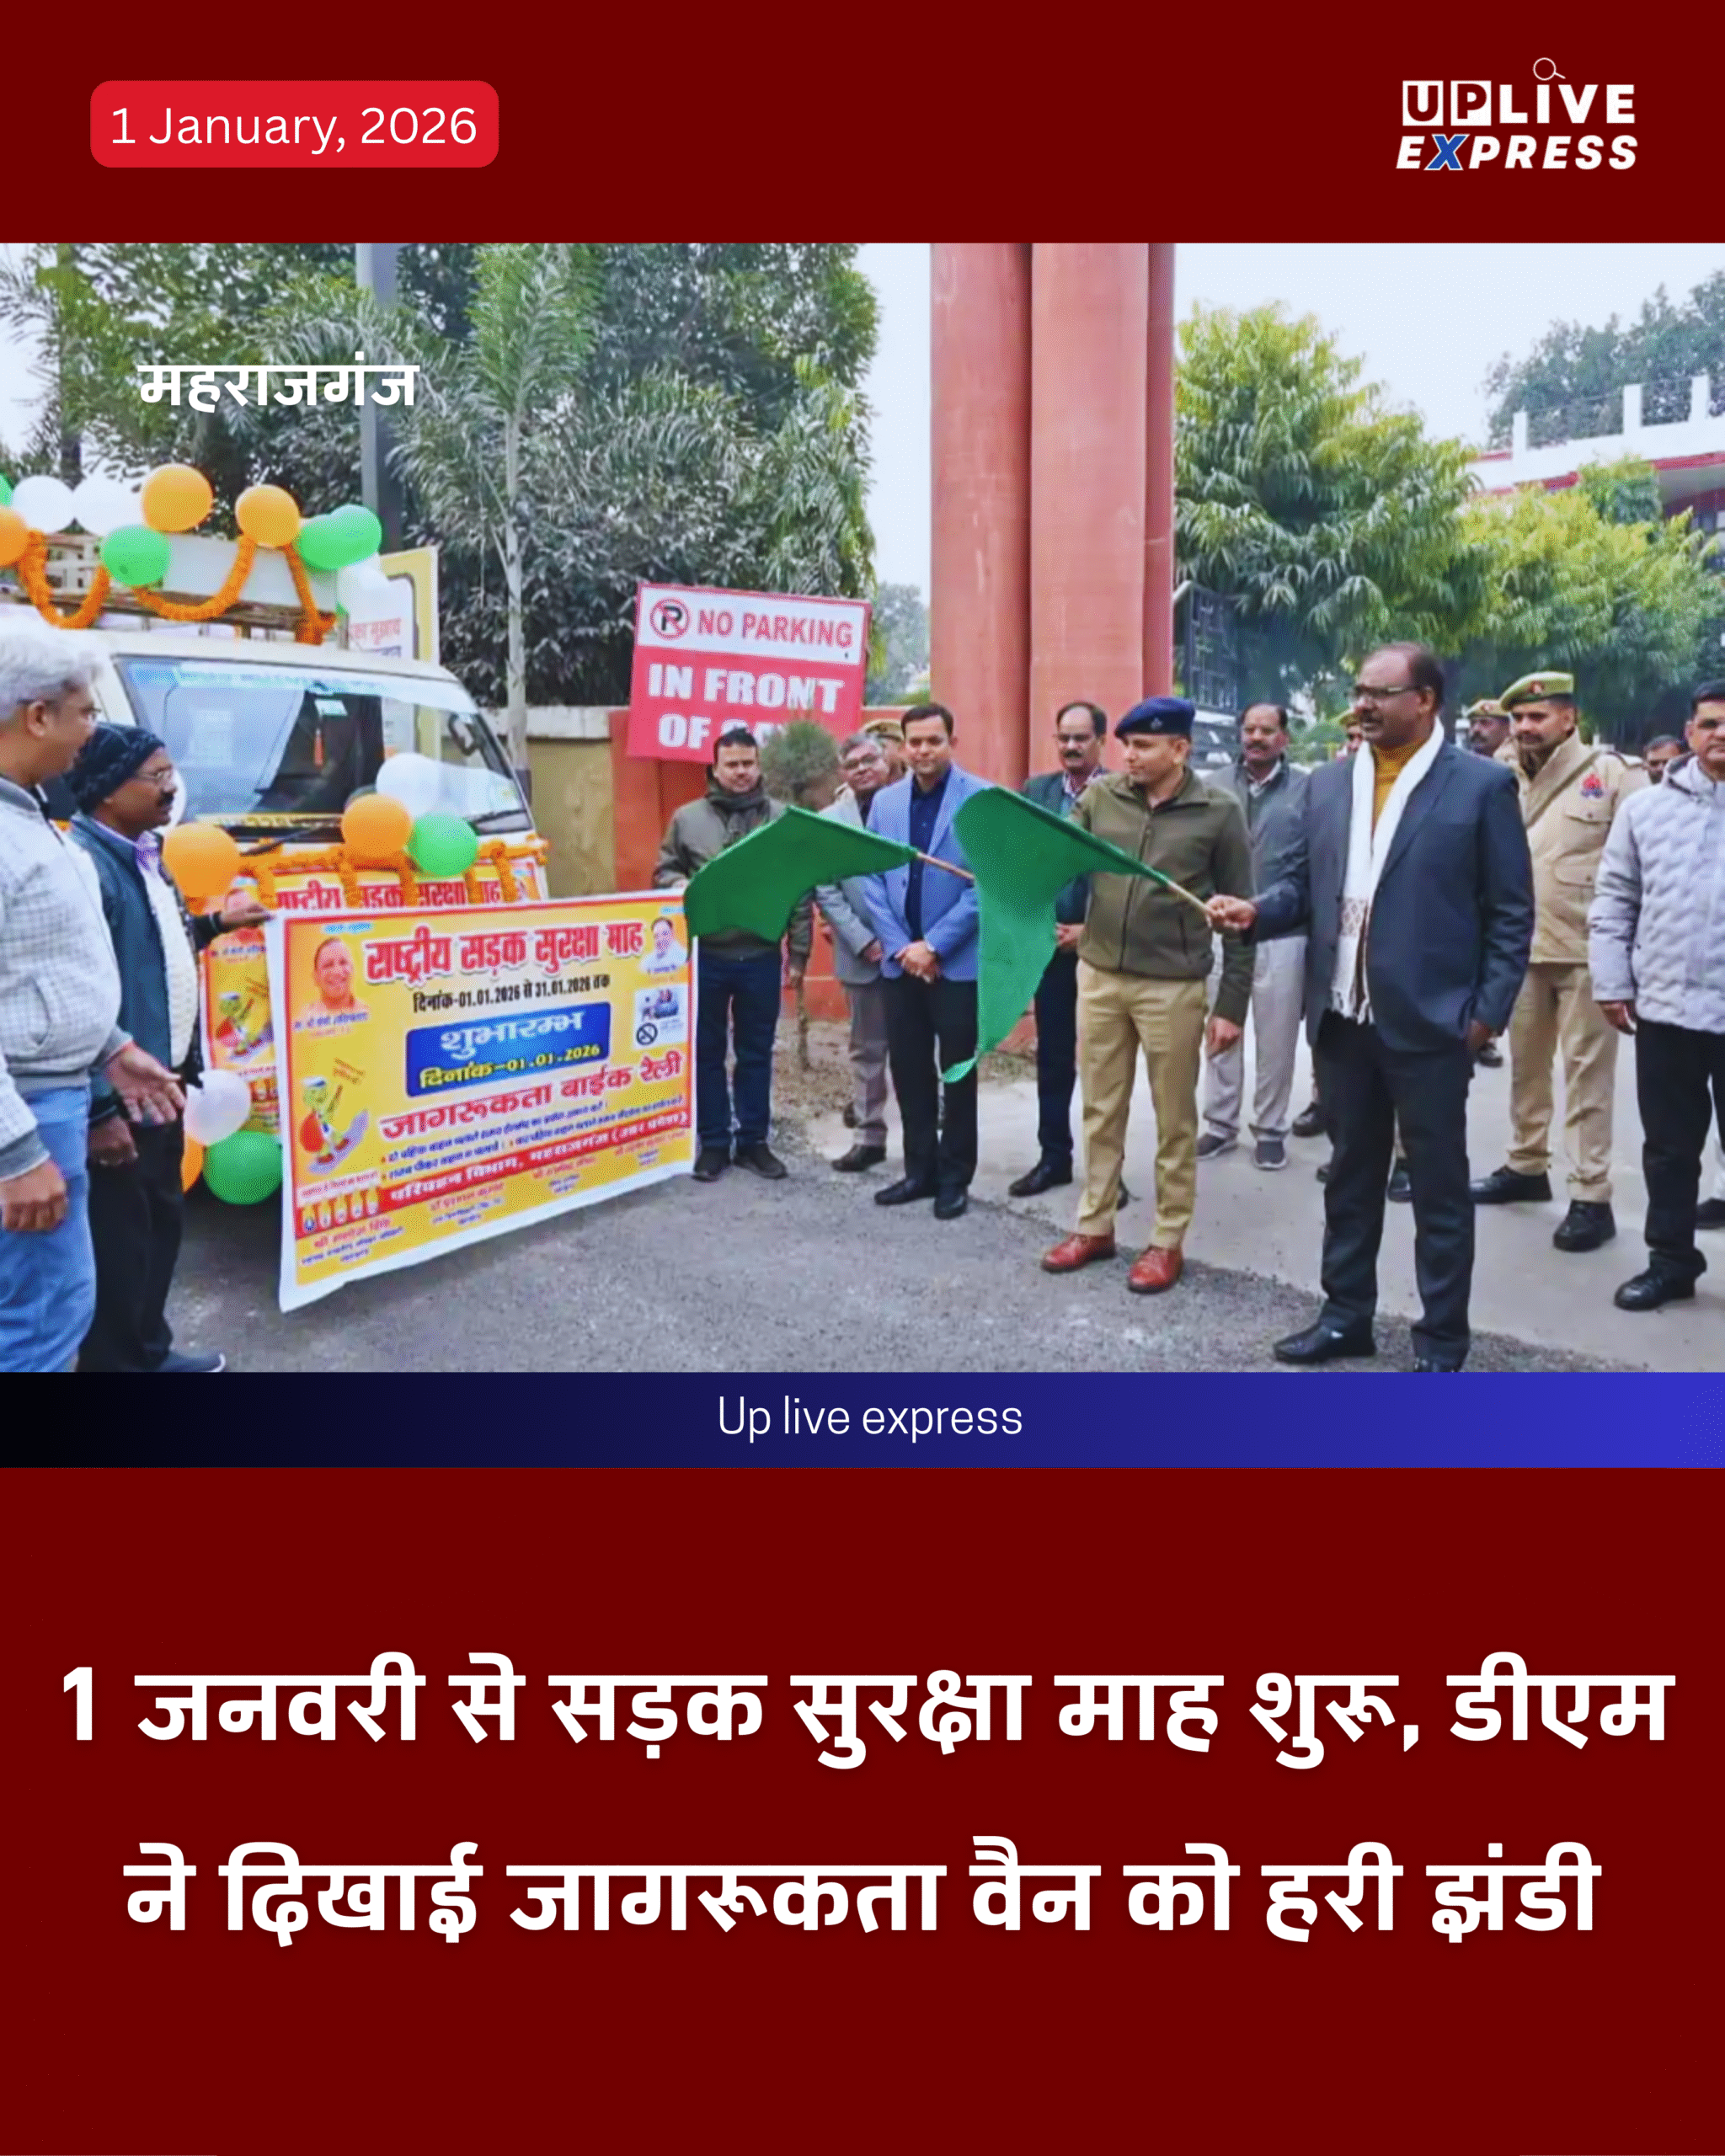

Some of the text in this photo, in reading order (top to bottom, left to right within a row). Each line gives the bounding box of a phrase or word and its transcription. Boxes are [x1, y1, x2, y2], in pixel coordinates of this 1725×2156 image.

[697, 608, 854, 649] NO PARKING
[648, 663, 846, 714] IN FRONT
[658, 712, 713, 750] OF
[366, 921, 644, 985] राष्ट्रीय सड़क सुरक्षा माह
[523, 979, 533, 999] से
[592, 974, 611, 989] तक
[440, 1010, 585, 1060] शुभारम्भ
[380, 1083, 553, 1139] जागरूकता
